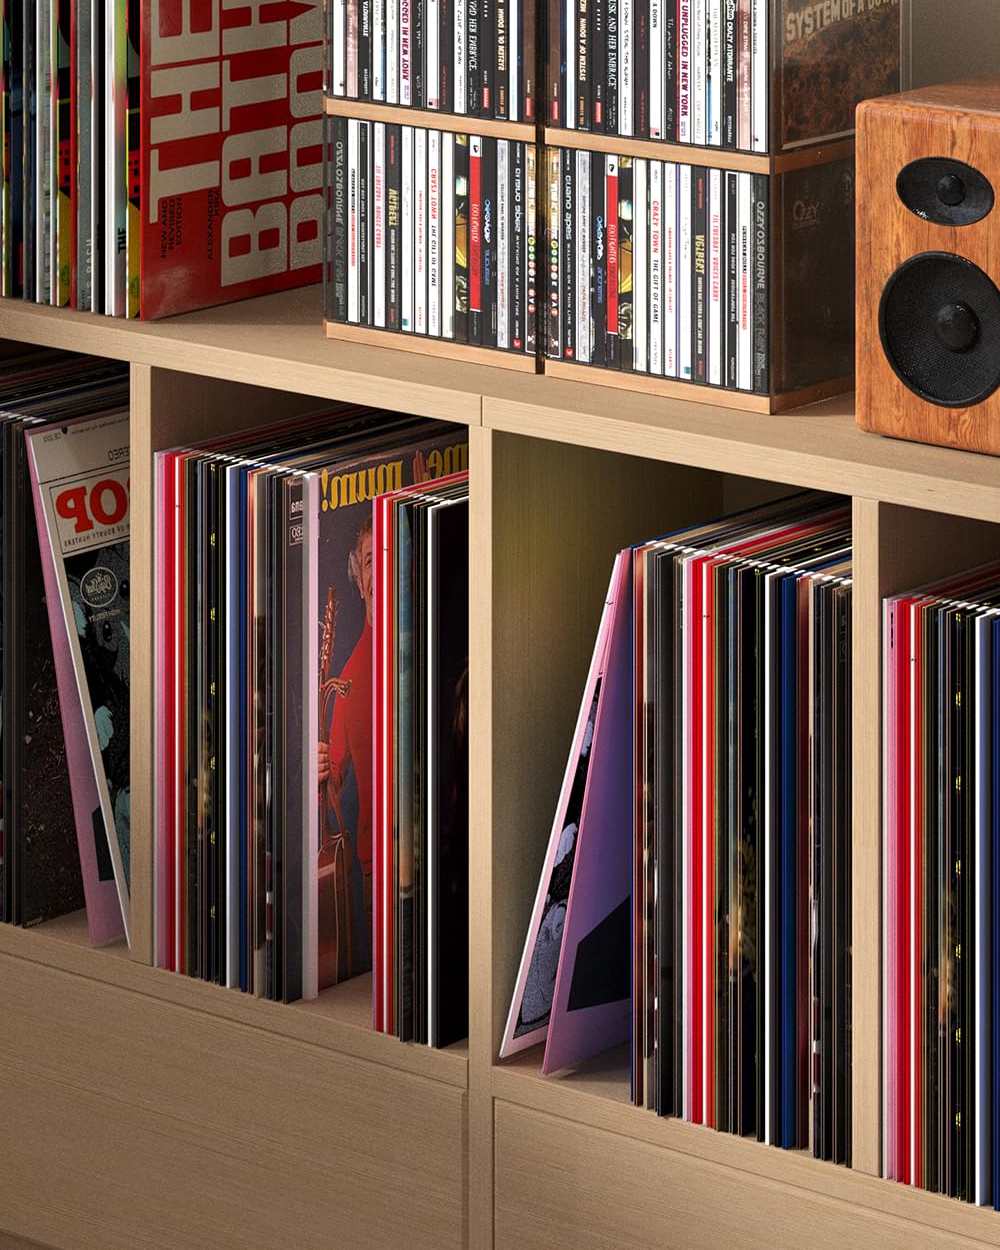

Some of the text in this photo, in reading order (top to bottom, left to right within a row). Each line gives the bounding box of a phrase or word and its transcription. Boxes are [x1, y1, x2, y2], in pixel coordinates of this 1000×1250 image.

[608, 15, 617, 32] AND
[681, 5, 689, 57] UNPLUGGED
[726, 21, 734, 43] CRAZY
[608, 34, 617, 50] HER
[726, 43, 734, 82] ATORRANTE
[681, 72, 689, 91] NEW
[681, 93, 689, 117] YORK
[160, 200, 169, 259] NEW AND
[175, 197, 183, 246] EDITION
[756, 201, 765, 231] OZZY
[756, 230, 765, 289] OSBOURNE
